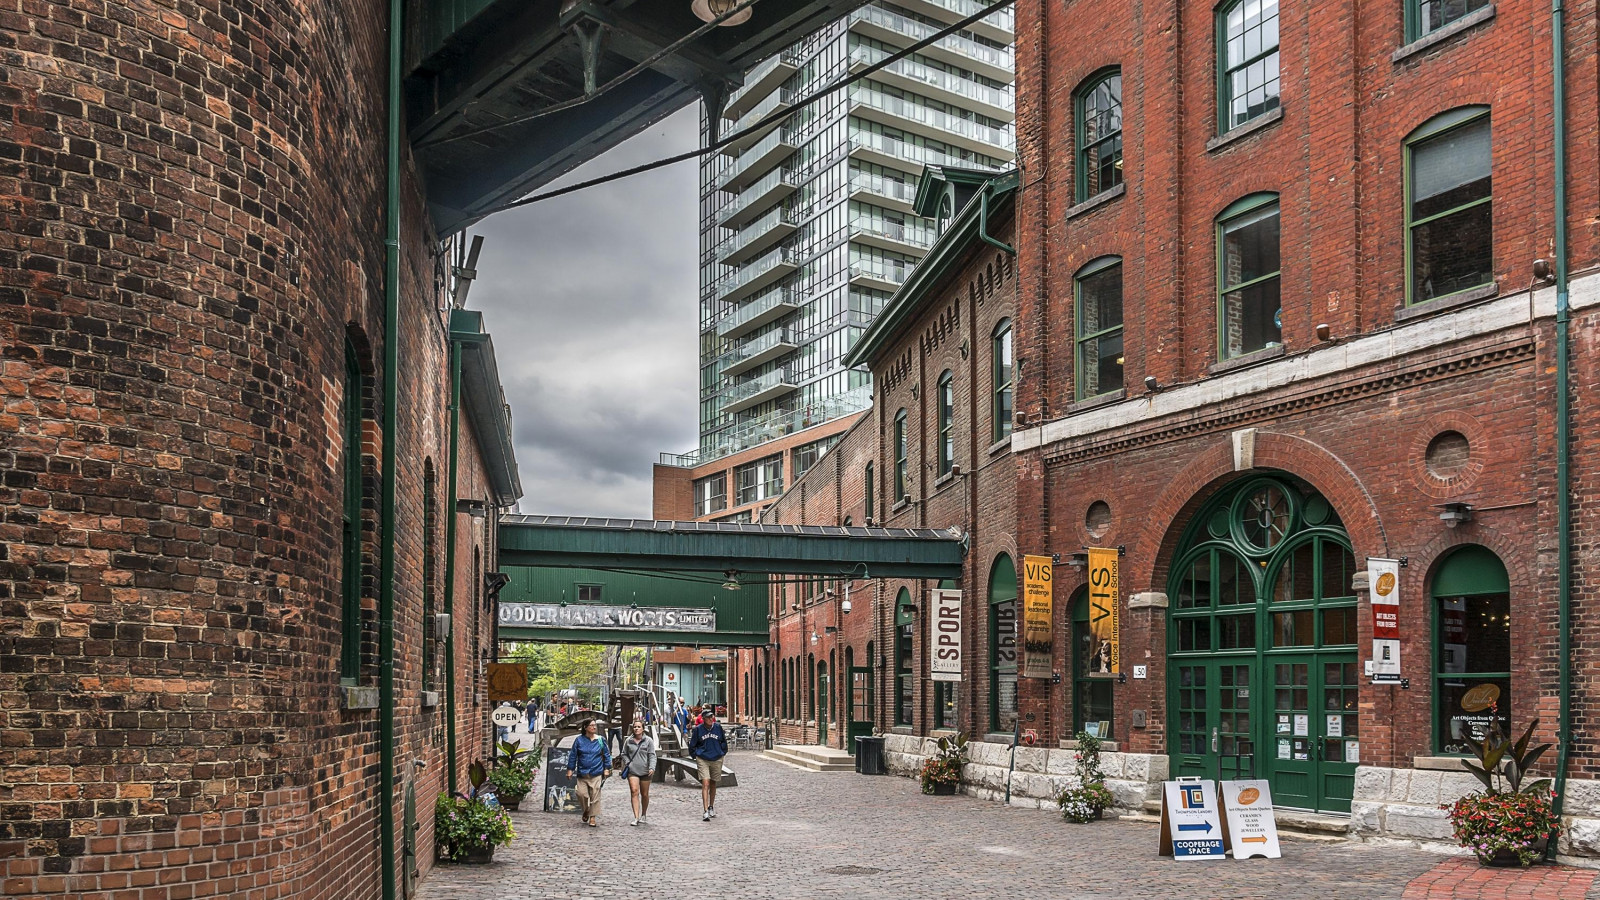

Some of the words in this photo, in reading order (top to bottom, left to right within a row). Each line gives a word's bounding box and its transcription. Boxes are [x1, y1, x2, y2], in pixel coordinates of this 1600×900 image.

[1026, 564, 1051, 582] VIS
[1028, 589, 1050, 597] challenge
[1091, 567, 1110, 623] VIS
[617, 610, 676, 626] WORTS
[679, 615, 709, 624] LIMITED
[1027, 606, 1051, 614] leadership
[1111, 590, 1119, 641] Intermediate
[937, 591, 961, 661] SPORT
[1111, 643, 1119, 667] Voice
[495, 713, 517, 721] OPEN
